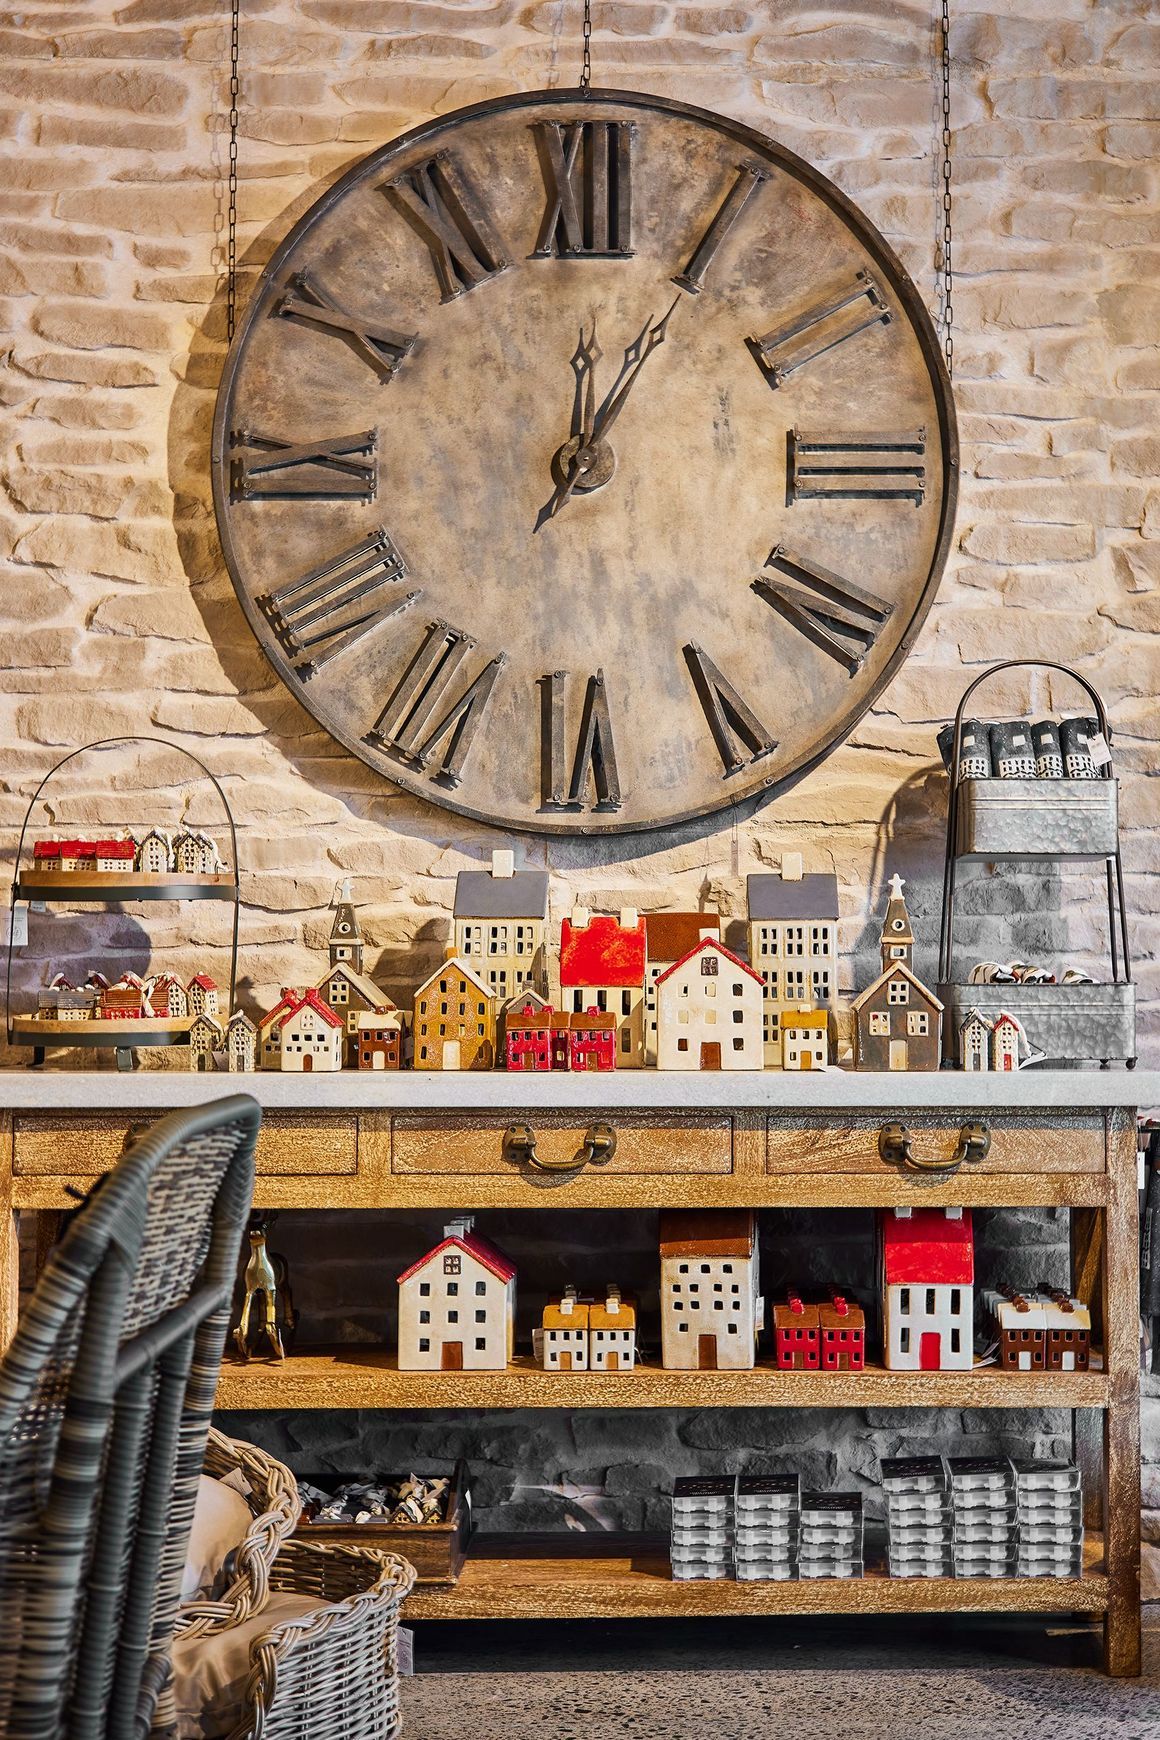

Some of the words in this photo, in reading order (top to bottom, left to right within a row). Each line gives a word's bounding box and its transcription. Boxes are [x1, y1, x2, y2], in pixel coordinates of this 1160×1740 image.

[377, 149, 514, 304] XI
[531, 119, 636, 258] XII
[672, 159, 769, 294] I
[269, 267, 418, 383] X
[745, 268, 892, 390] II
[231, 426, 378, 505] IX
[786, 425, 925, 506] III
[683, 640, 779, 779] V
